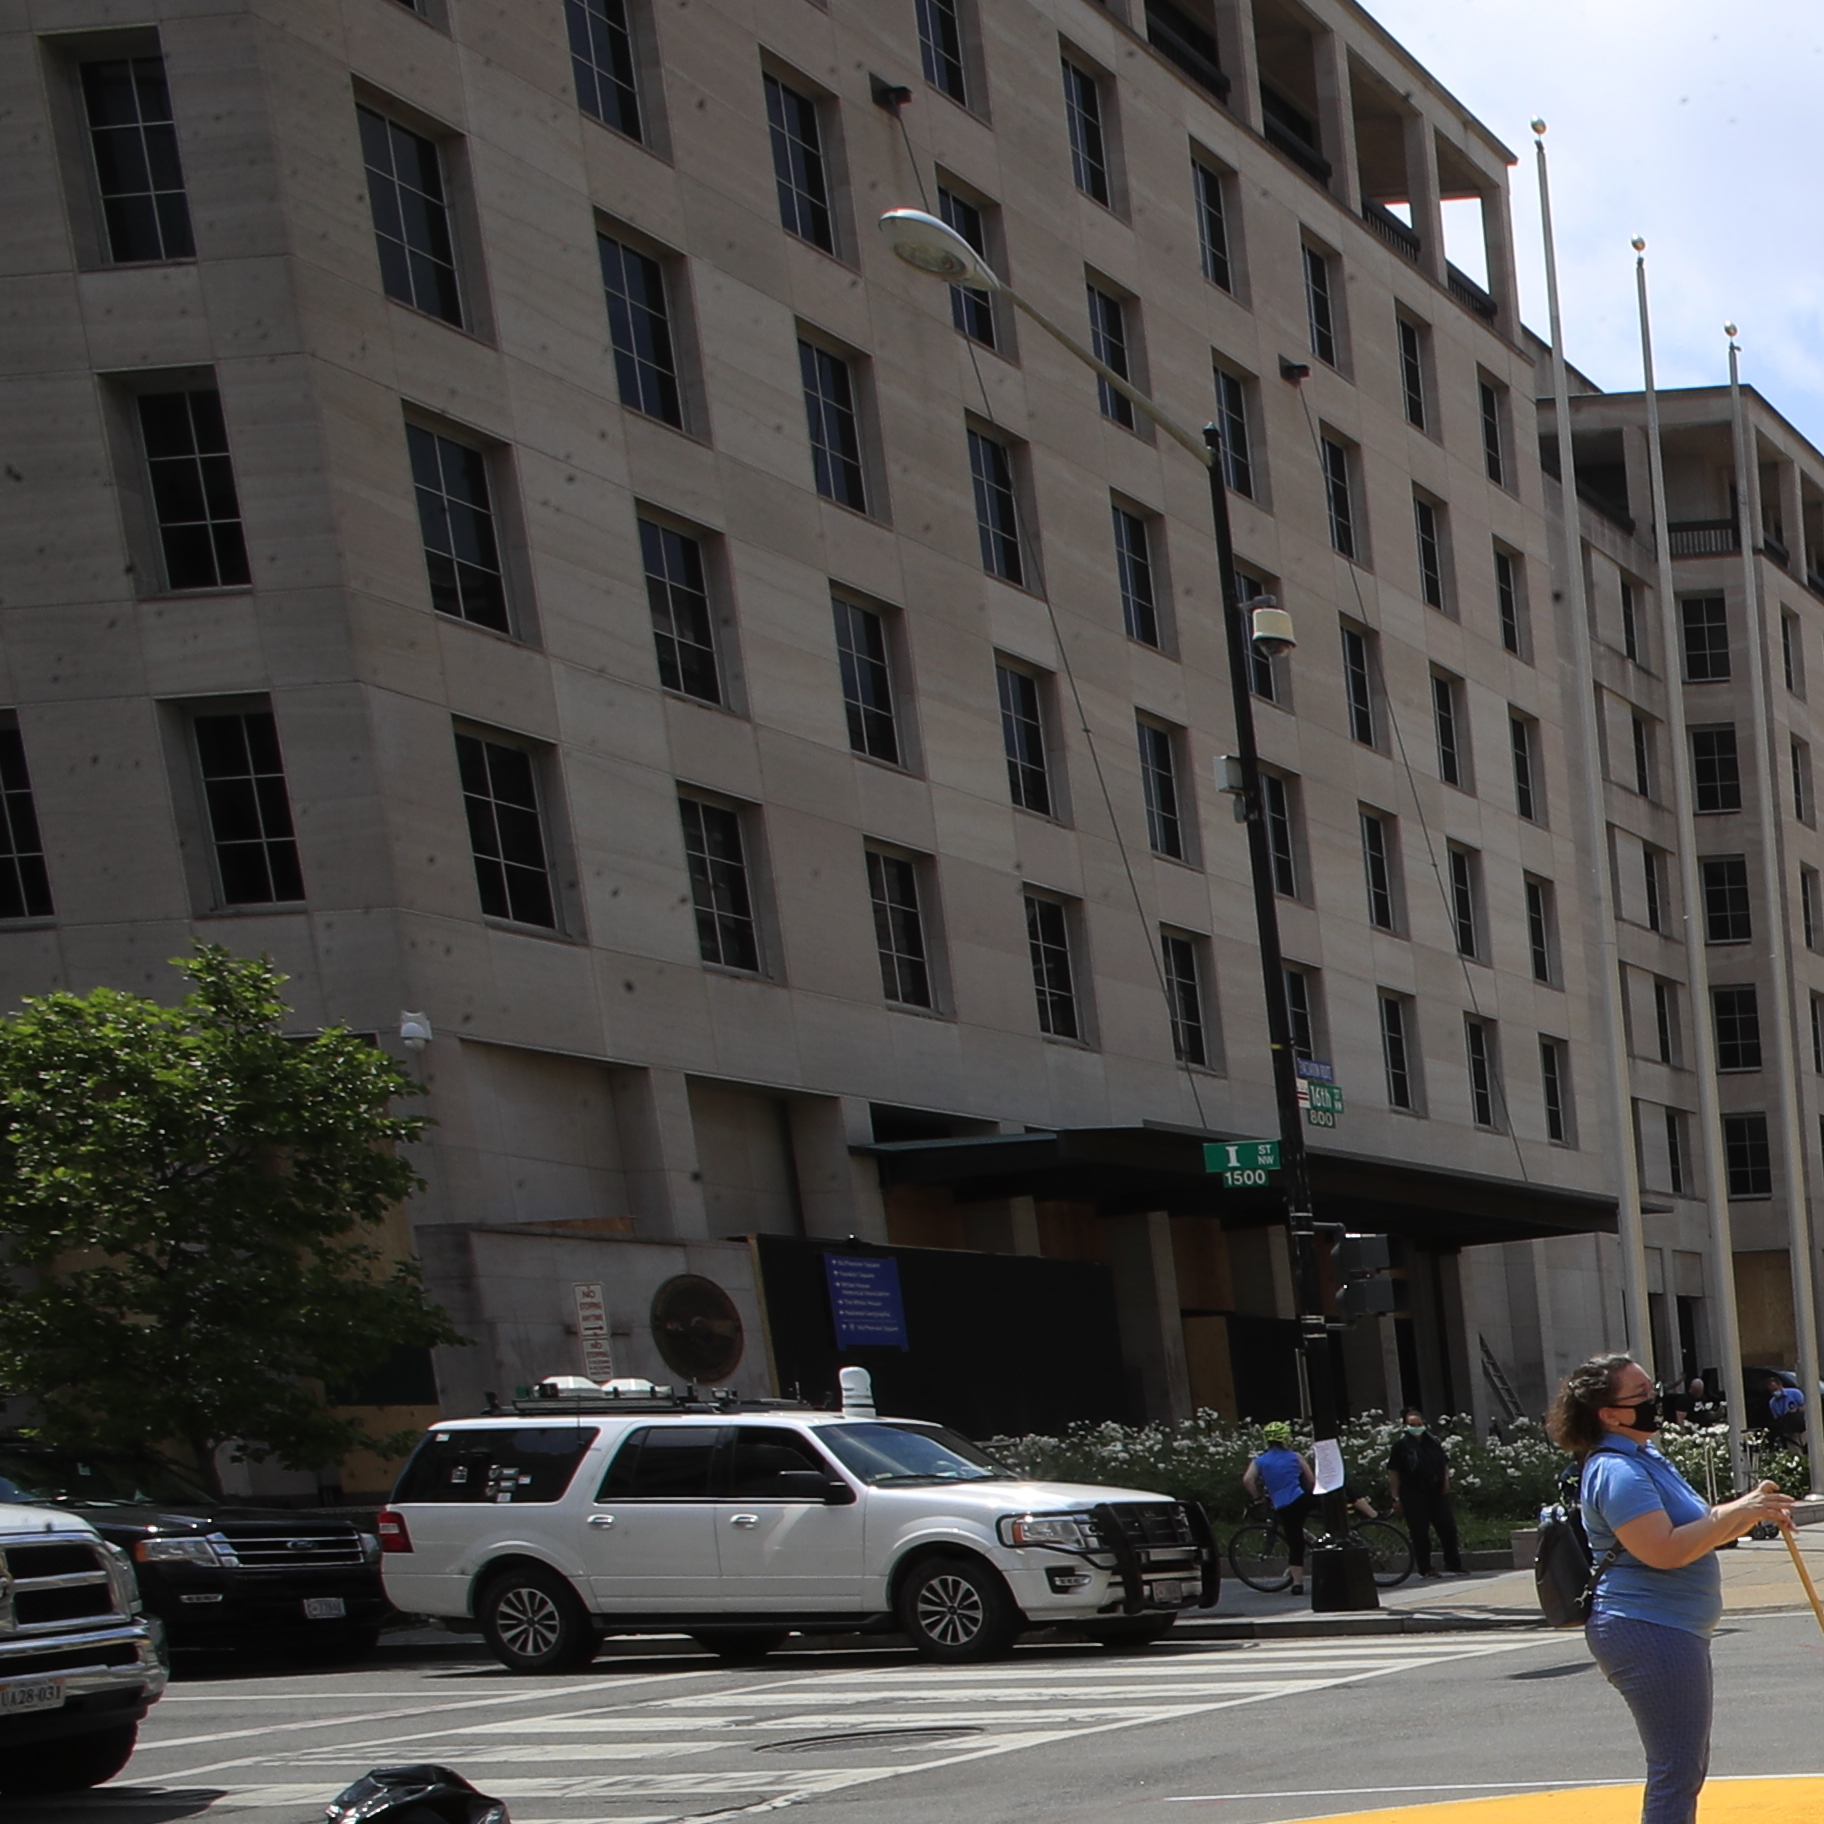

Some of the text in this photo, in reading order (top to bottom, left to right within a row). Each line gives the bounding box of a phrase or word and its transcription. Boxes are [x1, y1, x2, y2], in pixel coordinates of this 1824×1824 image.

[1310, 1109, 1333, 1127] 800
[1225, 1144, 1272, 1167] I ST
[1258, 1155, 1275, 1165] NW
[1225, 1169, 1266, 1186] 1500
